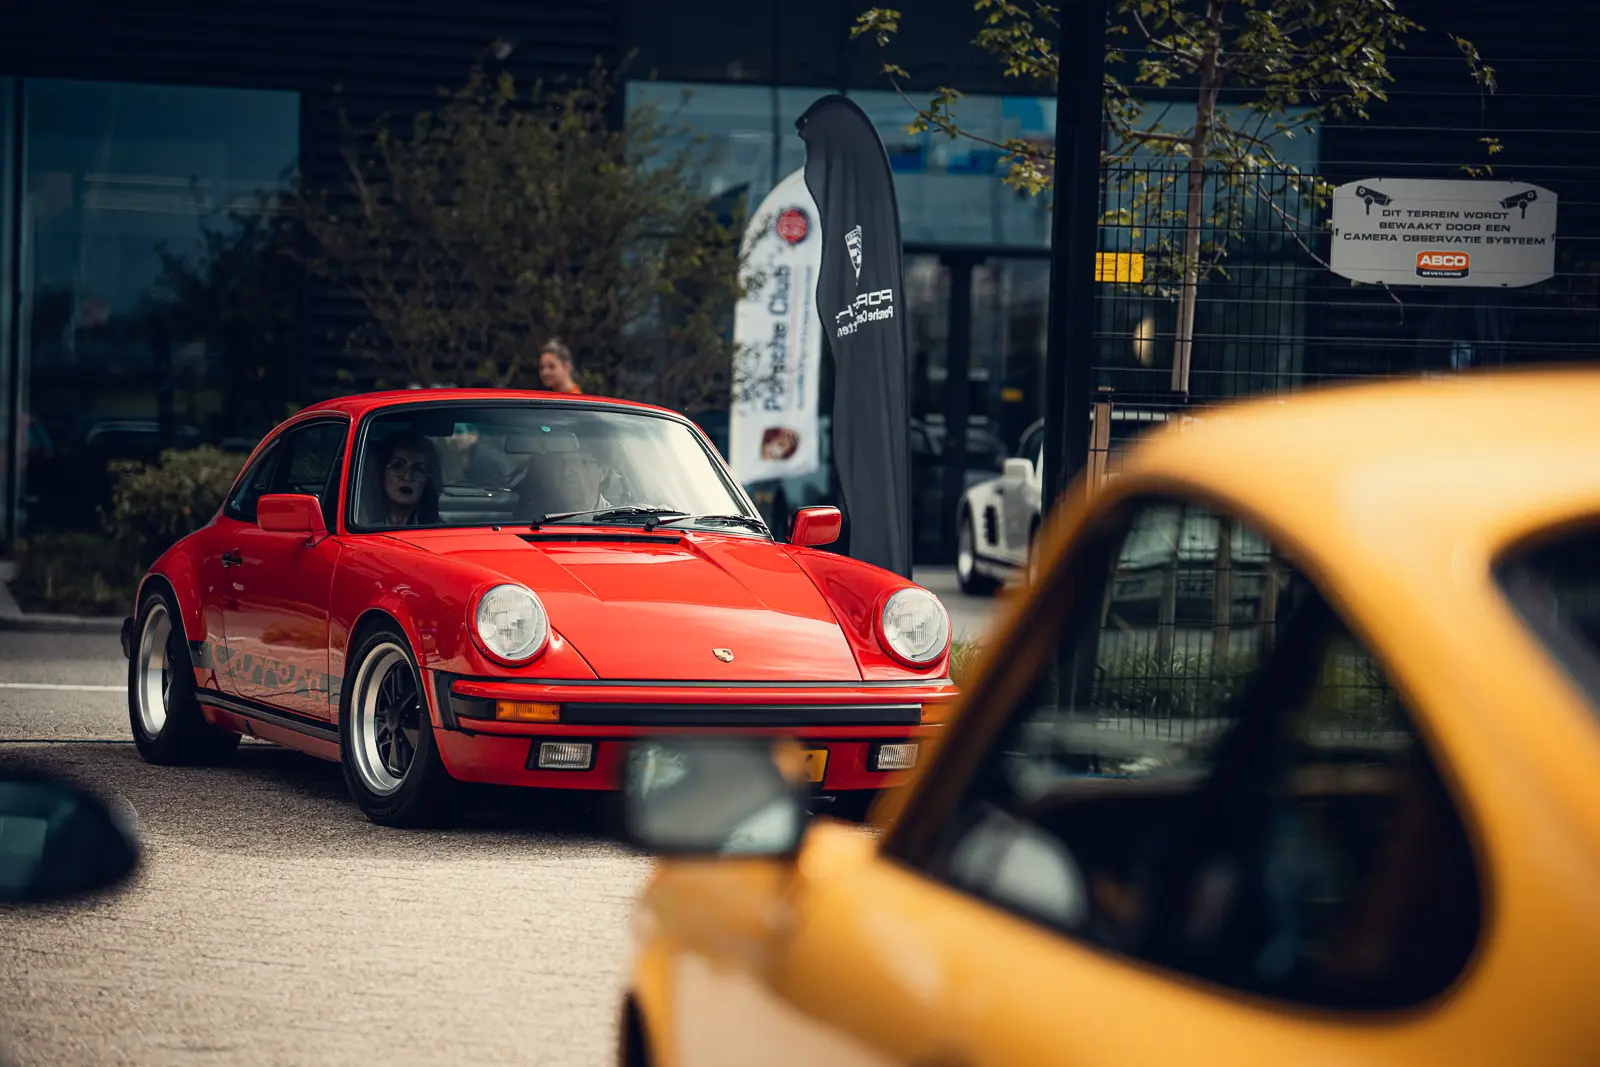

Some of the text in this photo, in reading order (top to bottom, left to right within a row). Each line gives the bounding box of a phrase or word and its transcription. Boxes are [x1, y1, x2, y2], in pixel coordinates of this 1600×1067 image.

[1382, 209, 1510, 220] DIT TERREIN WORDT
[1379, 221, 1511, 233] BEWAAKT DOOR EEN
[1343, 232, 1546, 246] CAMERA OBSERVATIE SYSTEEM
[1419, 254, 1467, 267] ABCO
[768, 264, 790, 316] Club
